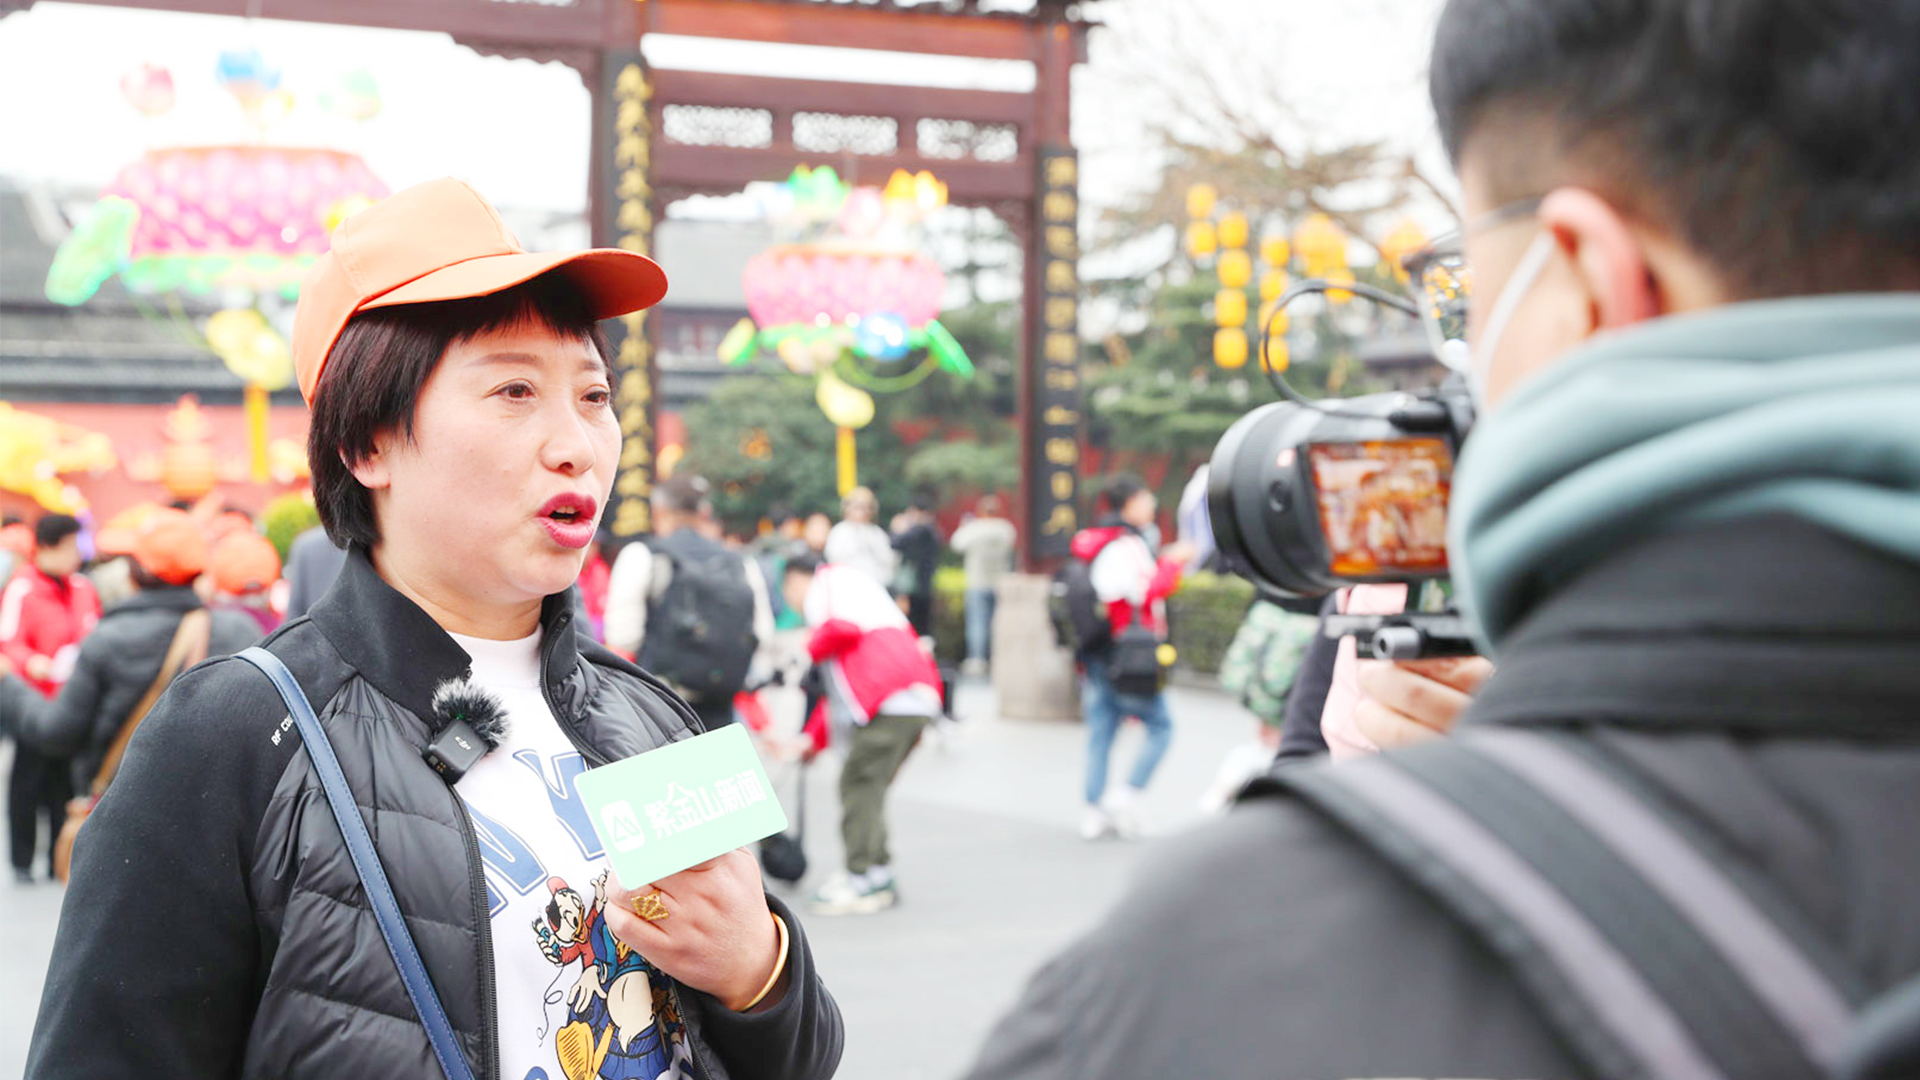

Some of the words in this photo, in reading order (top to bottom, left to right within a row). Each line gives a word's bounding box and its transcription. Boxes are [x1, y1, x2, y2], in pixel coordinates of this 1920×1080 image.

[644, 767, 767, 840] 紫金山新闻
